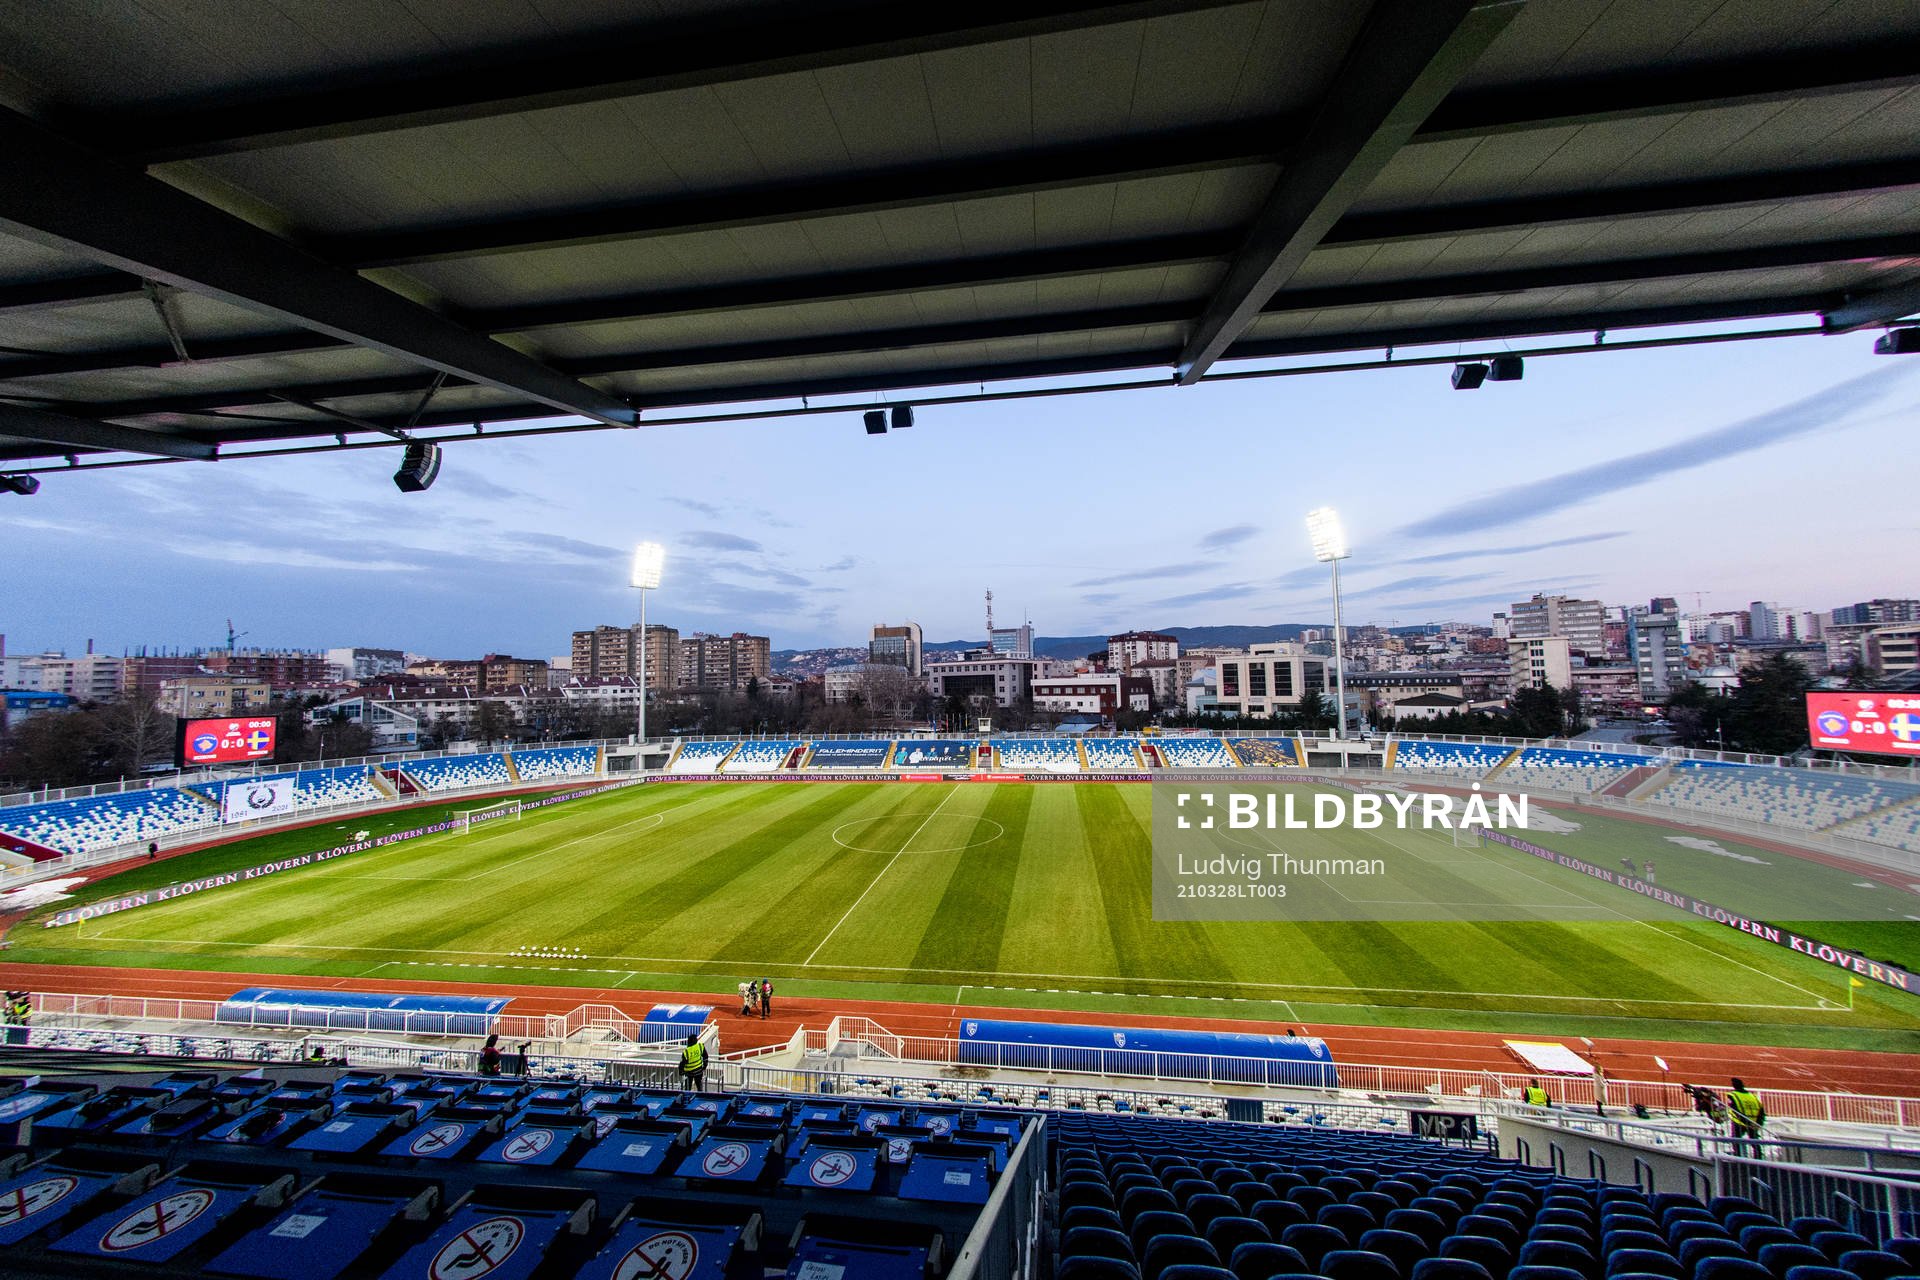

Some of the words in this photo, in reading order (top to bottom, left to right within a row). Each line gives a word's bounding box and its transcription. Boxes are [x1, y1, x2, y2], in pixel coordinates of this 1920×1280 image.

[157, 873, 238, 901] KLÖVERN
[245, 855, 311, 879] KLÖVERN
[315, 840, 372, 861] KLÖVERN
[375, 828, 423, 847] KLÖVERN
[1510, 838, 1554, 861] KLÖVERN
[1558, 855, 1612, 882] KLÖVERN
[1617, 875, 1685, 908] KLÖVERN
[1692, 901, 1781, 943] KLÖVERN
[1790, 935, 1908, 989] KLÖVERN
